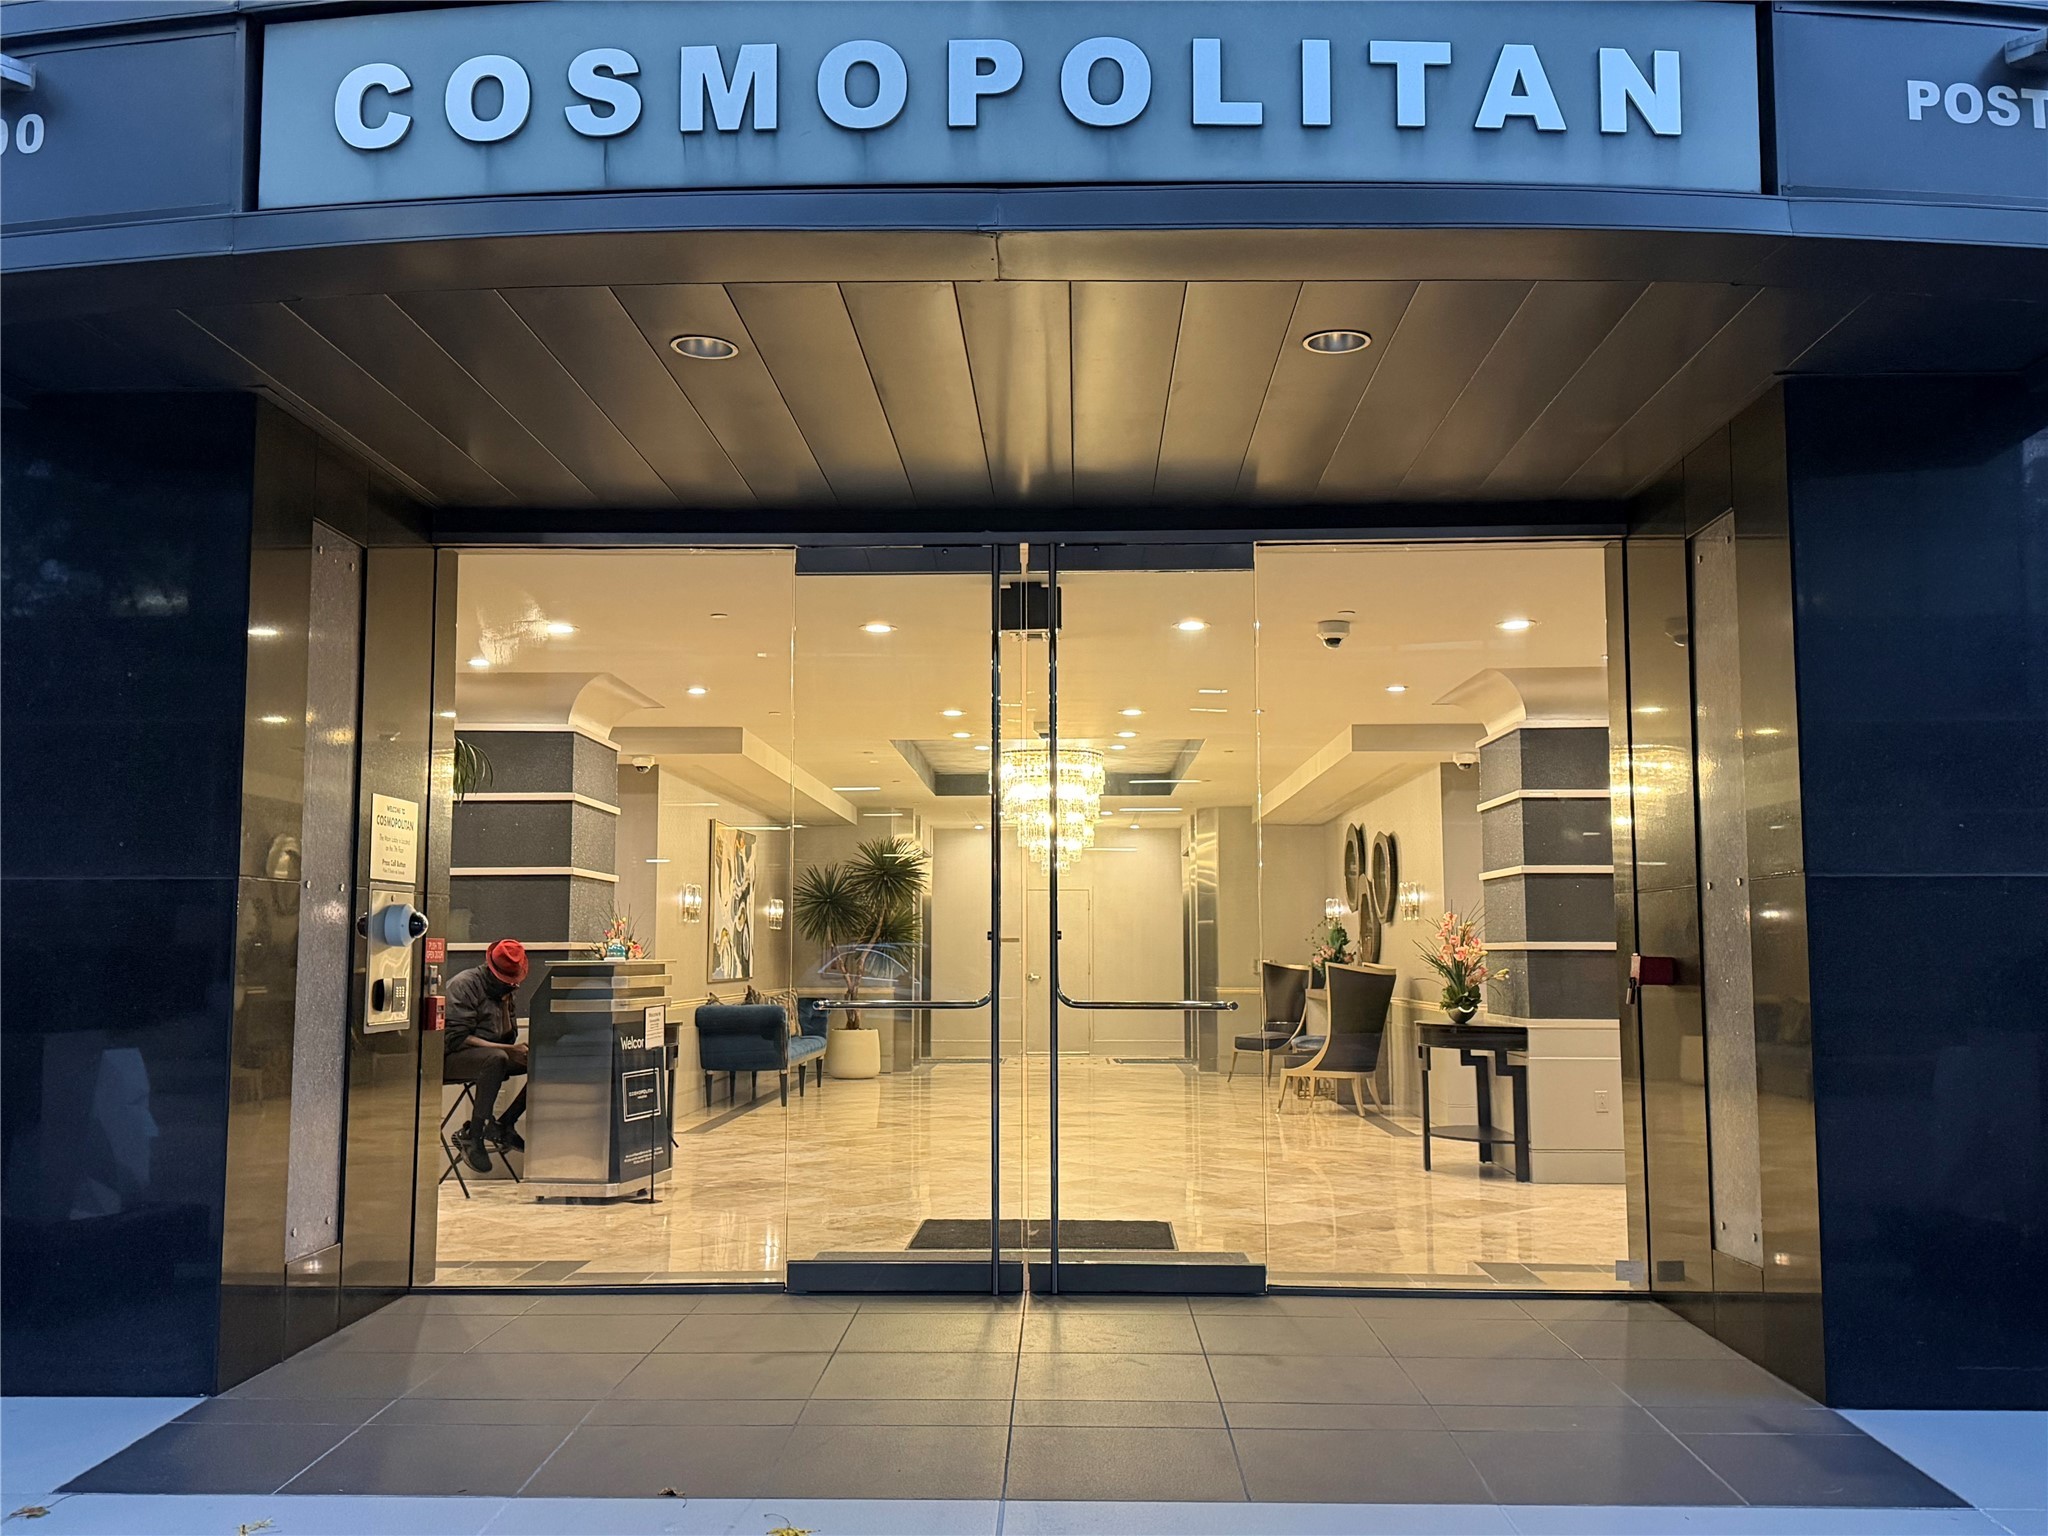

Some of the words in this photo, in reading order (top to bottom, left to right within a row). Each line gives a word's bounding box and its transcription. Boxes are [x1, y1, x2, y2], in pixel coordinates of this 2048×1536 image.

[334, 38, 1682, 150] COSMOPOLITAN
[1907, 79, 2048, 130] POST
[376, 814, 414, 831] COSMOPOLITAN
